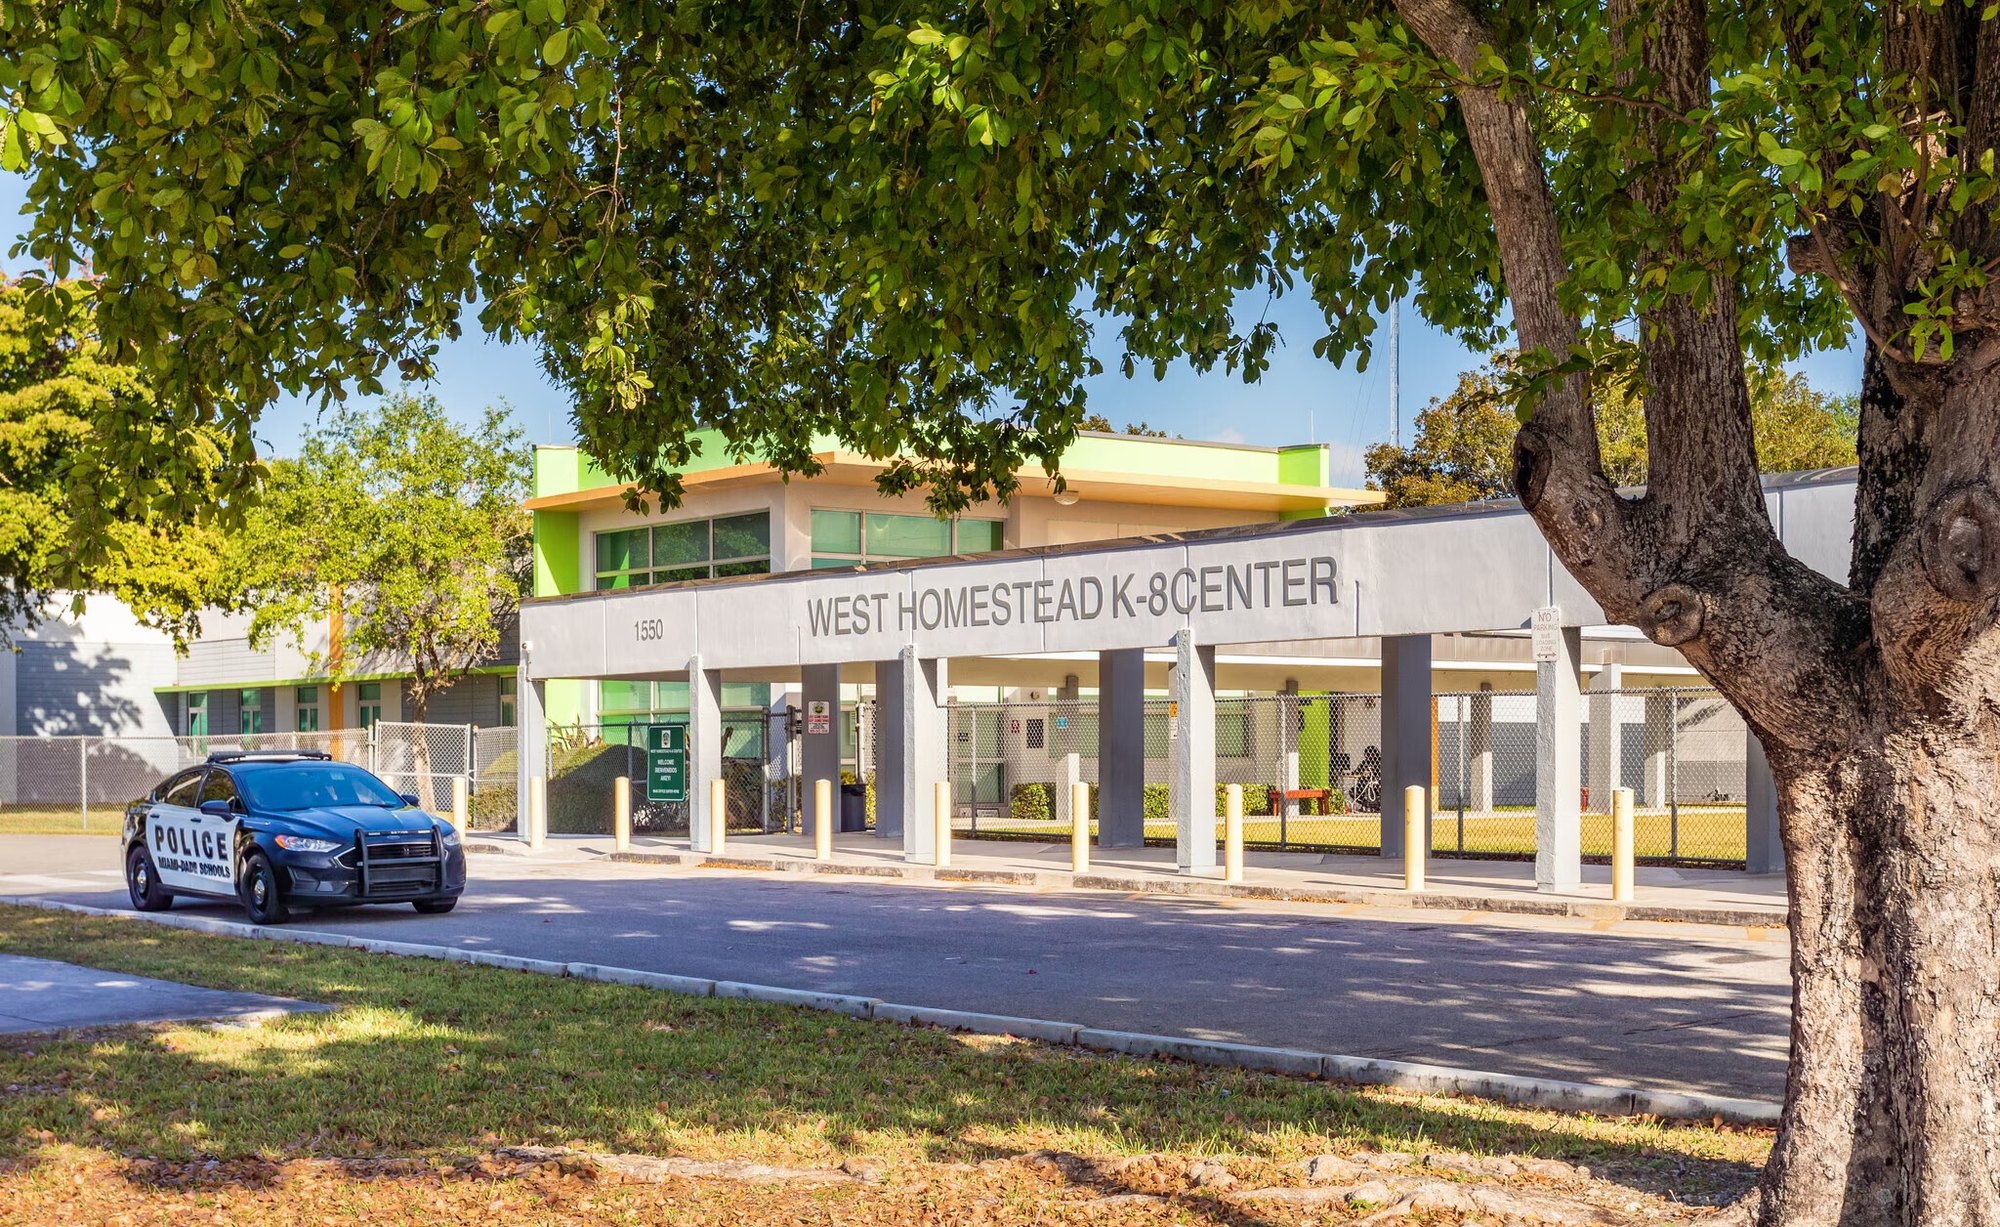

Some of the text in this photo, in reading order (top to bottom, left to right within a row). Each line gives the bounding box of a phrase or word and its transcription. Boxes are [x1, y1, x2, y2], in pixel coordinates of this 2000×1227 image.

[808, 556, 1339, 637] WEST HOMESTEAD K-8 CENTER
[1538, 611, 1552, 622] NO
[634, 618, 664, 641] 1550
[154, 824, 229, 861] POLICE
[158, 856, 231, 878] MIAMI-DADE SCHOOLS
